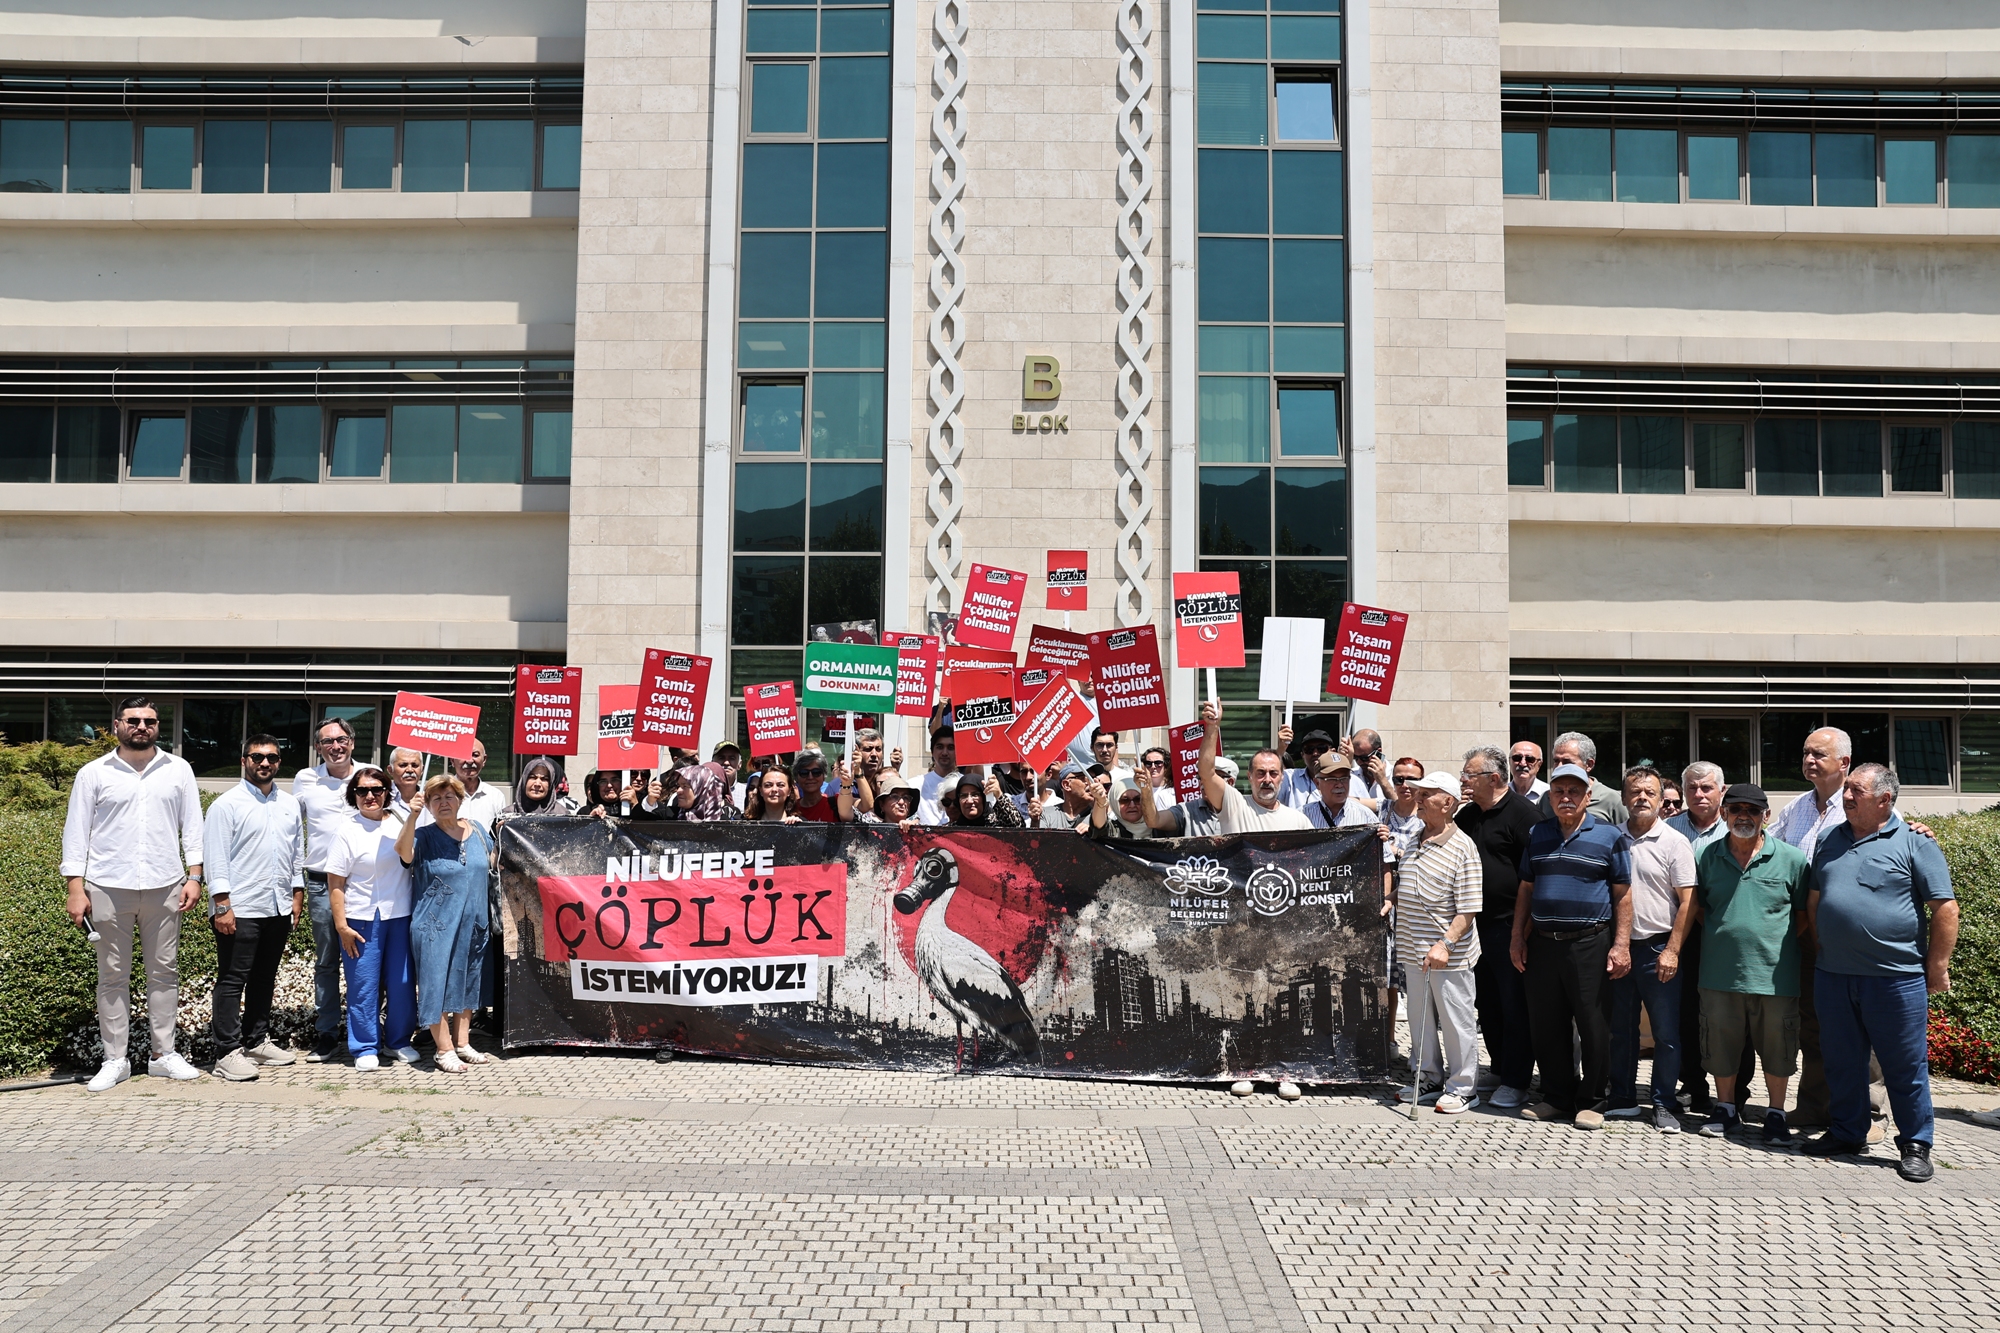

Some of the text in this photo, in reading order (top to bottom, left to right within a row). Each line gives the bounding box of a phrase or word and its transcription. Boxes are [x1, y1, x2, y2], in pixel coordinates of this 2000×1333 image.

[1025, 356, 1062, 400] B
[1012, 415, 1068, 430] BLOK
[1050, 571, 1085, 582] ÇÖPLÜK
[972, 592, 1014, 609] Nilüfer
[1187, 592, 1227, 600] KAYAPA'DA
[964, 603, 1017, 622] “çöplük”
[1178, 598, 1239, 617] ÇÖPLÜK
[964, 617, 1011, 634] olmasın
[1184, 614, 1234, 624] İSTEMİYORUZ!
[1033, 637, 1088, 651] Çocuklarımızı
[1349, 630, 1392, 650] Yaşam
[1030, 645, 1090, 660] Geleceğini Çöp
[1042, 655, 1079, 666] Atmayın!
[1341, 645, 1391, 664] alanına
[809, 660, 893, 676] ORMANIMA
[898, 657, 926, 668] emiz
[1101, 662, 1151, 679] Nilüfer
[1341, 660, 1387, 678] çöplük
[654, 676, 695, 693] Temiz
[897, 670, 925, 683] evre,
[1340, 674, 1382, 692] olmaz
[820, 680, 880, 691] DOKUNMA!
[897, 681, 927, 694] ğlıklı
[1096, 675, 1160, 697] “çöplük”
[527, 691, 571, 705] Yaşam
[651, 692, 692, 708] çevre,
[896, 695, 926, 706] şam!
[1103, 693, 1160, 710] olmasın
[398, 707, 474, 724] Çocuklarımızın
[523, 705, 572, 718] alanına
[644, 705, 695, 722] sağlıklı
[754, 707, 790, 719] Nilüfer
[957, 701, 1011, 721] ÇÖPLÜK
[1017, 685, 1068, 746] Çocuklarımızın
[394, 716, 474, 734] Geleceğini Çöpe
[524, 718, 570, 732] çöplük
[602, 715, 634, 730] ÇÖPL
[642, 720, 692, 736] yaşam!
[750, 716, 796, 730] “çöplük”
[955, 715, 1015, 729] YAPTIRMAYACAĞIZ!
[1022, 713, 1058, 755] Geleceğini
[1056, 691, 1075, 713] Çöpe
[1039, 710, 1072, 750] Atmayın!
[410, 728, 458, 742] Atmayın!
[526, 732, 567, 744] olmaz
[754, 729, 795, 740] olmasın
[1180, 748, 1200, 761] Tem
[1300, 864, 1352, 881] NİLÜFER
[1300, 881, 1331, 893] KENT
[1170, 896, 1229, 909] NİLÜFER
[1300, 890, 1354, 906] KONSEYİ
[555, 878, 833, 960] ÇÖPLÜK
[1170, 909, 1228, 919] BELEDİYESİ
[580, 962, 807, 996] İSTEMİYORUZ!
